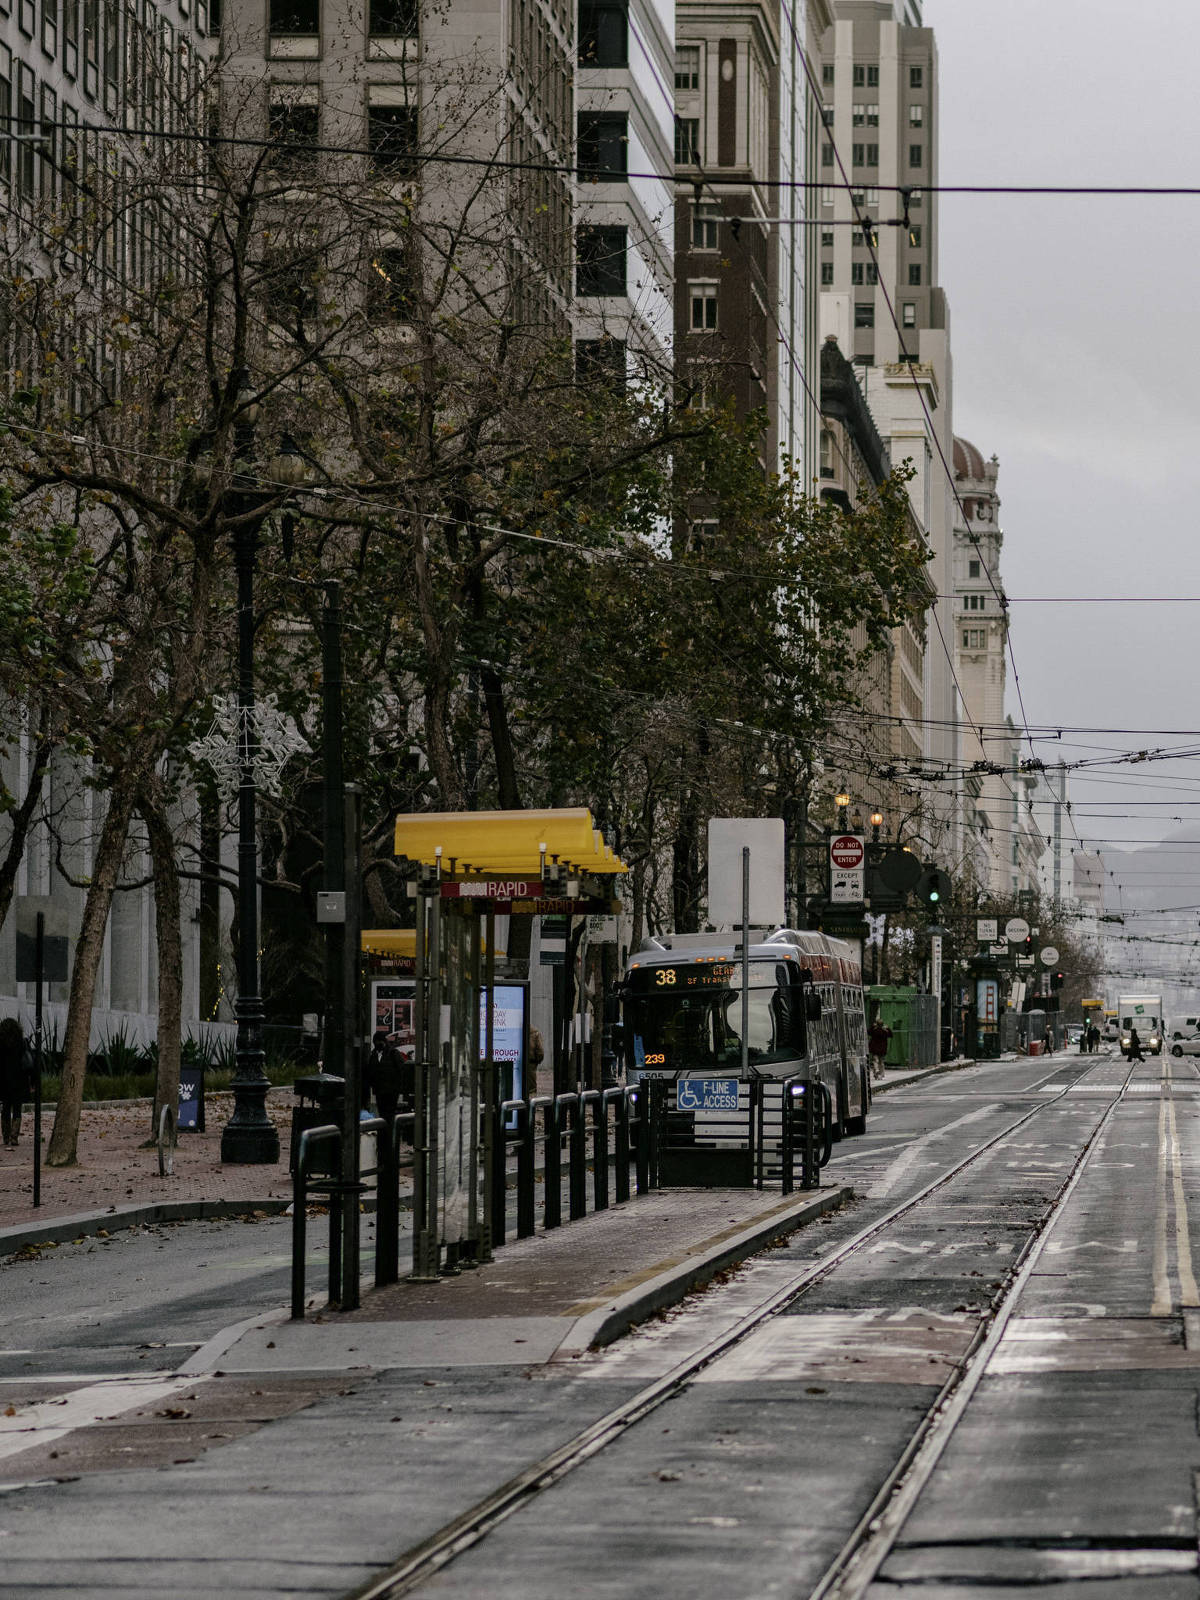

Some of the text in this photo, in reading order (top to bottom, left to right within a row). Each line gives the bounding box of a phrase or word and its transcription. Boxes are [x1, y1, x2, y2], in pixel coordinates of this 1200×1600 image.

[489, 881, 527, 897] RAPID
[537, 901, 574, 914] RAPID
[655, 968, 677, 985] 38
[645, 1054, 665, 1064] 239
[704, 1081, 729, 1094] F-LINE
[704, 1096, 736, 1108] ACCESS
